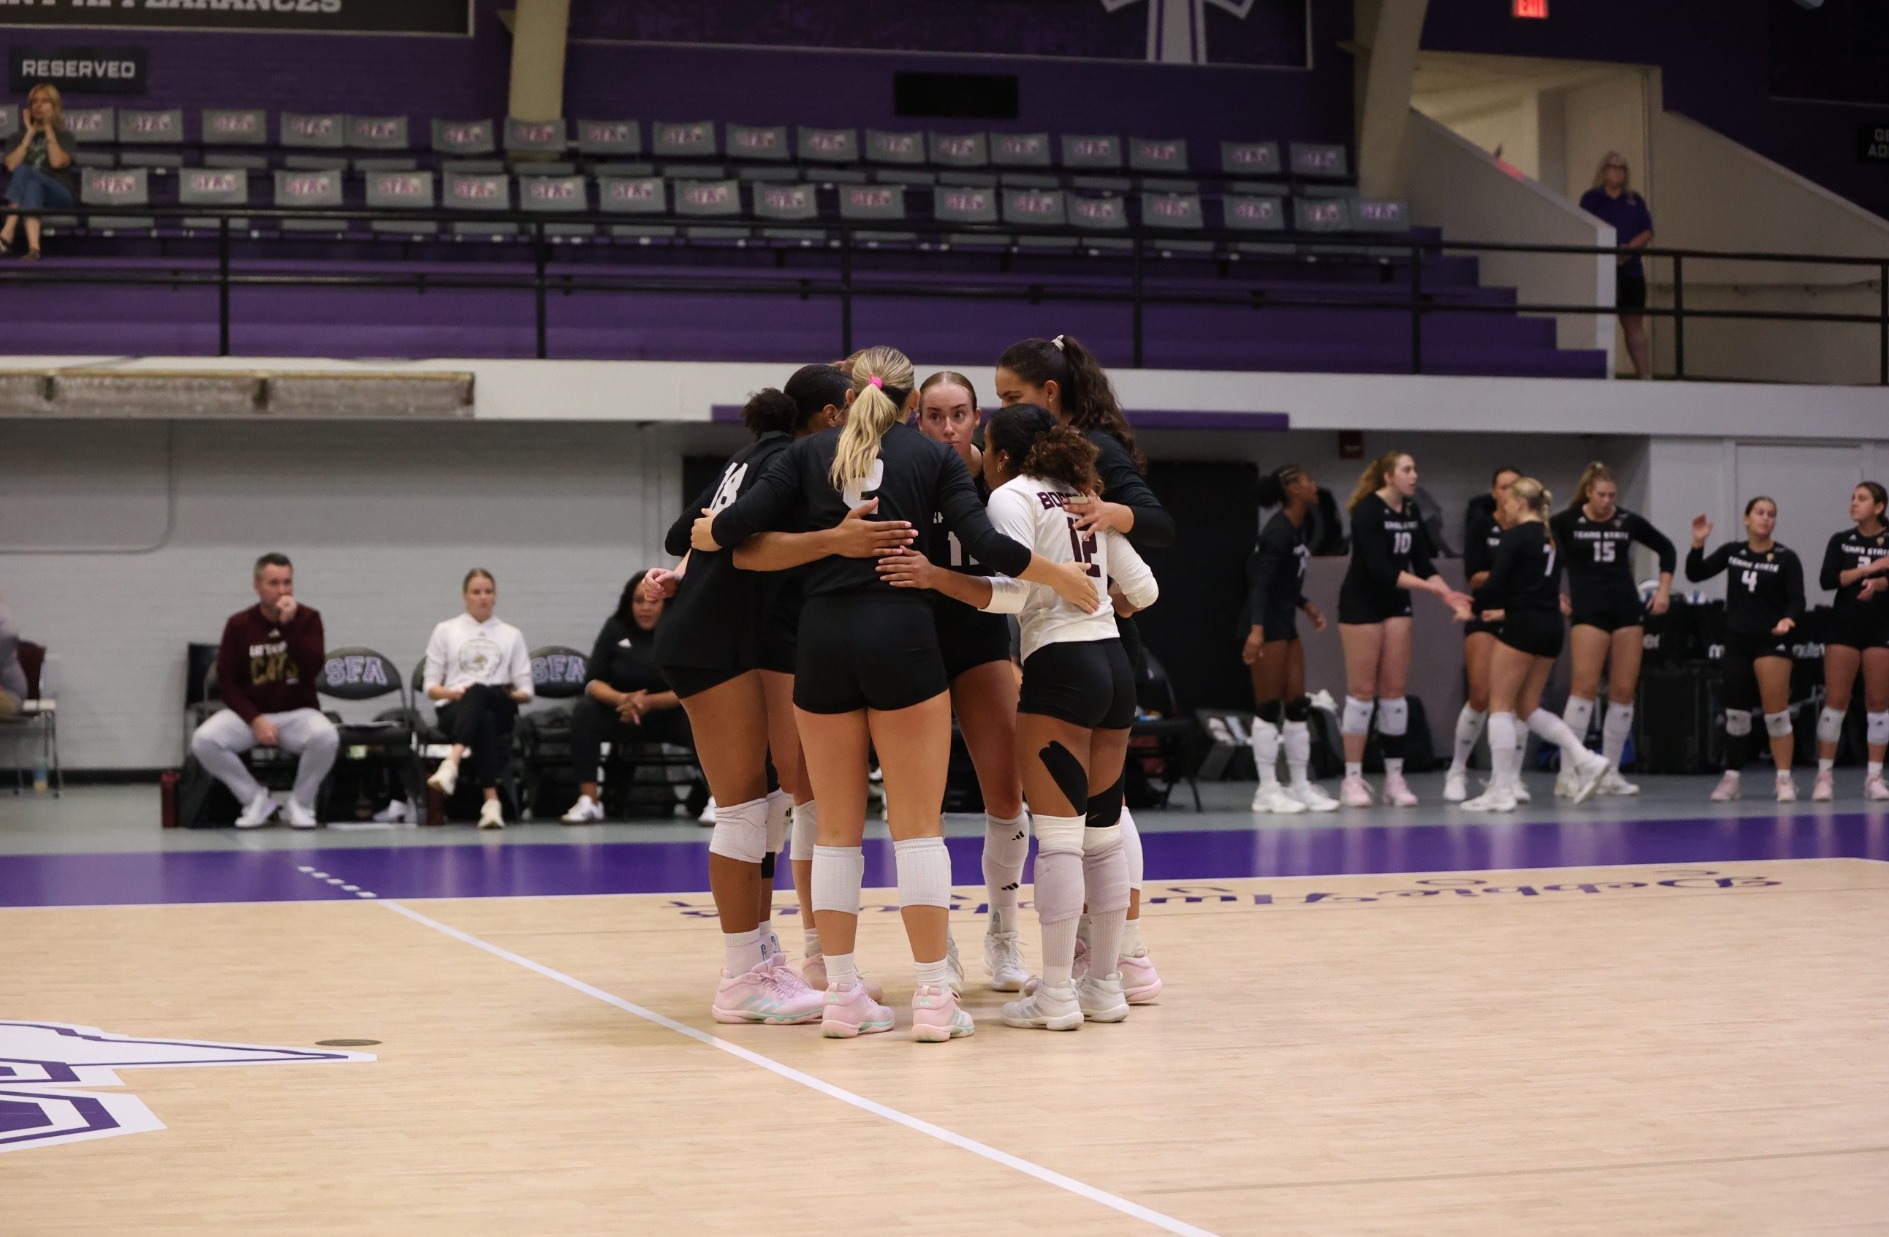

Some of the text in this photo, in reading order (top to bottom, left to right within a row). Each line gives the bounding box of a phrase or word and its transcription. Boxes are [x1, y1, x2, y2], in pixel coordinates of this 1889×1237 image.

[22, 59, 136, 78] RESERVED
[947, 530, 980, 567] 1
[1067, 516, 1102, 578] 12
[1393, 531, 1412, 554] 10
[1593, 540, 1616, 562] 15
[1741, 570, 1758, 593] 4
[325, 655, 388, 687] SFA
[530, 655, 587, 683] SFA
